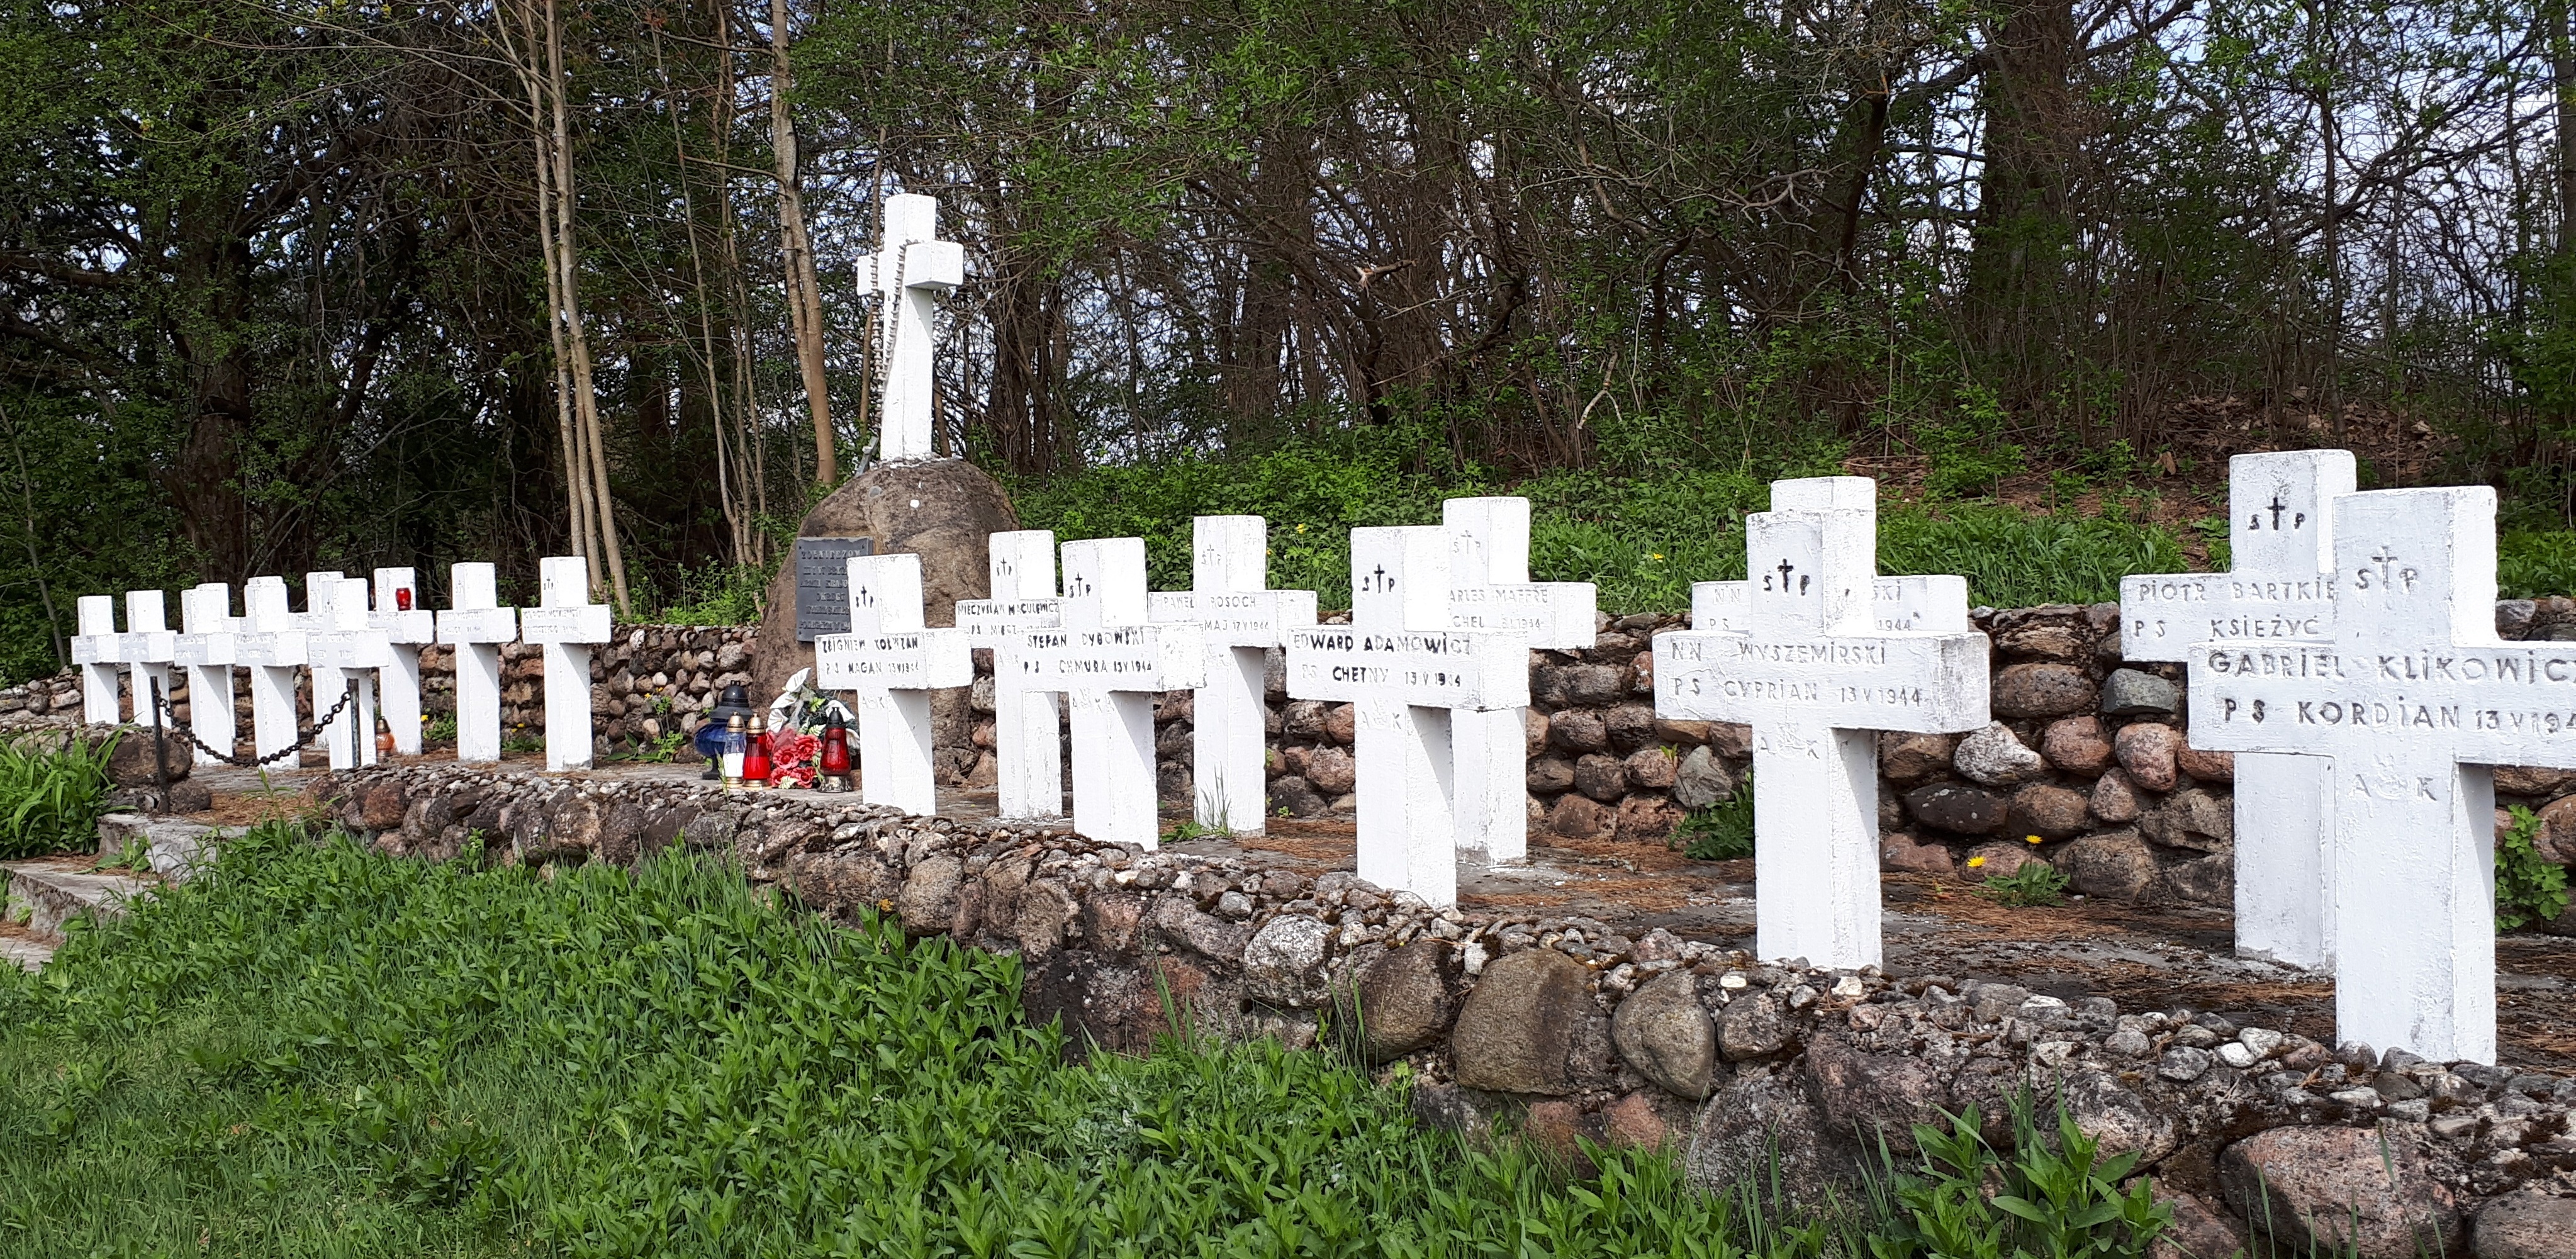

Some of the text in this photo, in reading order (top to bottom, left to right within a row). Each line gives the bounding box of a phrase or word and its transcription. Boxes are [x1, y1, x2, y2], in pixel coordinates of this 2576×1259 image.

[1450, 589, 1485, 603] ARLES
[1874, 579, 1901, 602] SKI
[2139, 578, 2334, 602] PIOTR BARTKIE
[1027, 634, 1067, 649] STEFAN
[1294, 632, 1470, 656] EDWARD ADAMOWICZ
[2208, 648, 2576, 685] GABRIEL KLIKOWIC
[2297, 695, 2460, 730] KORDIAN
[2530, 711, 2576, 734] 194
